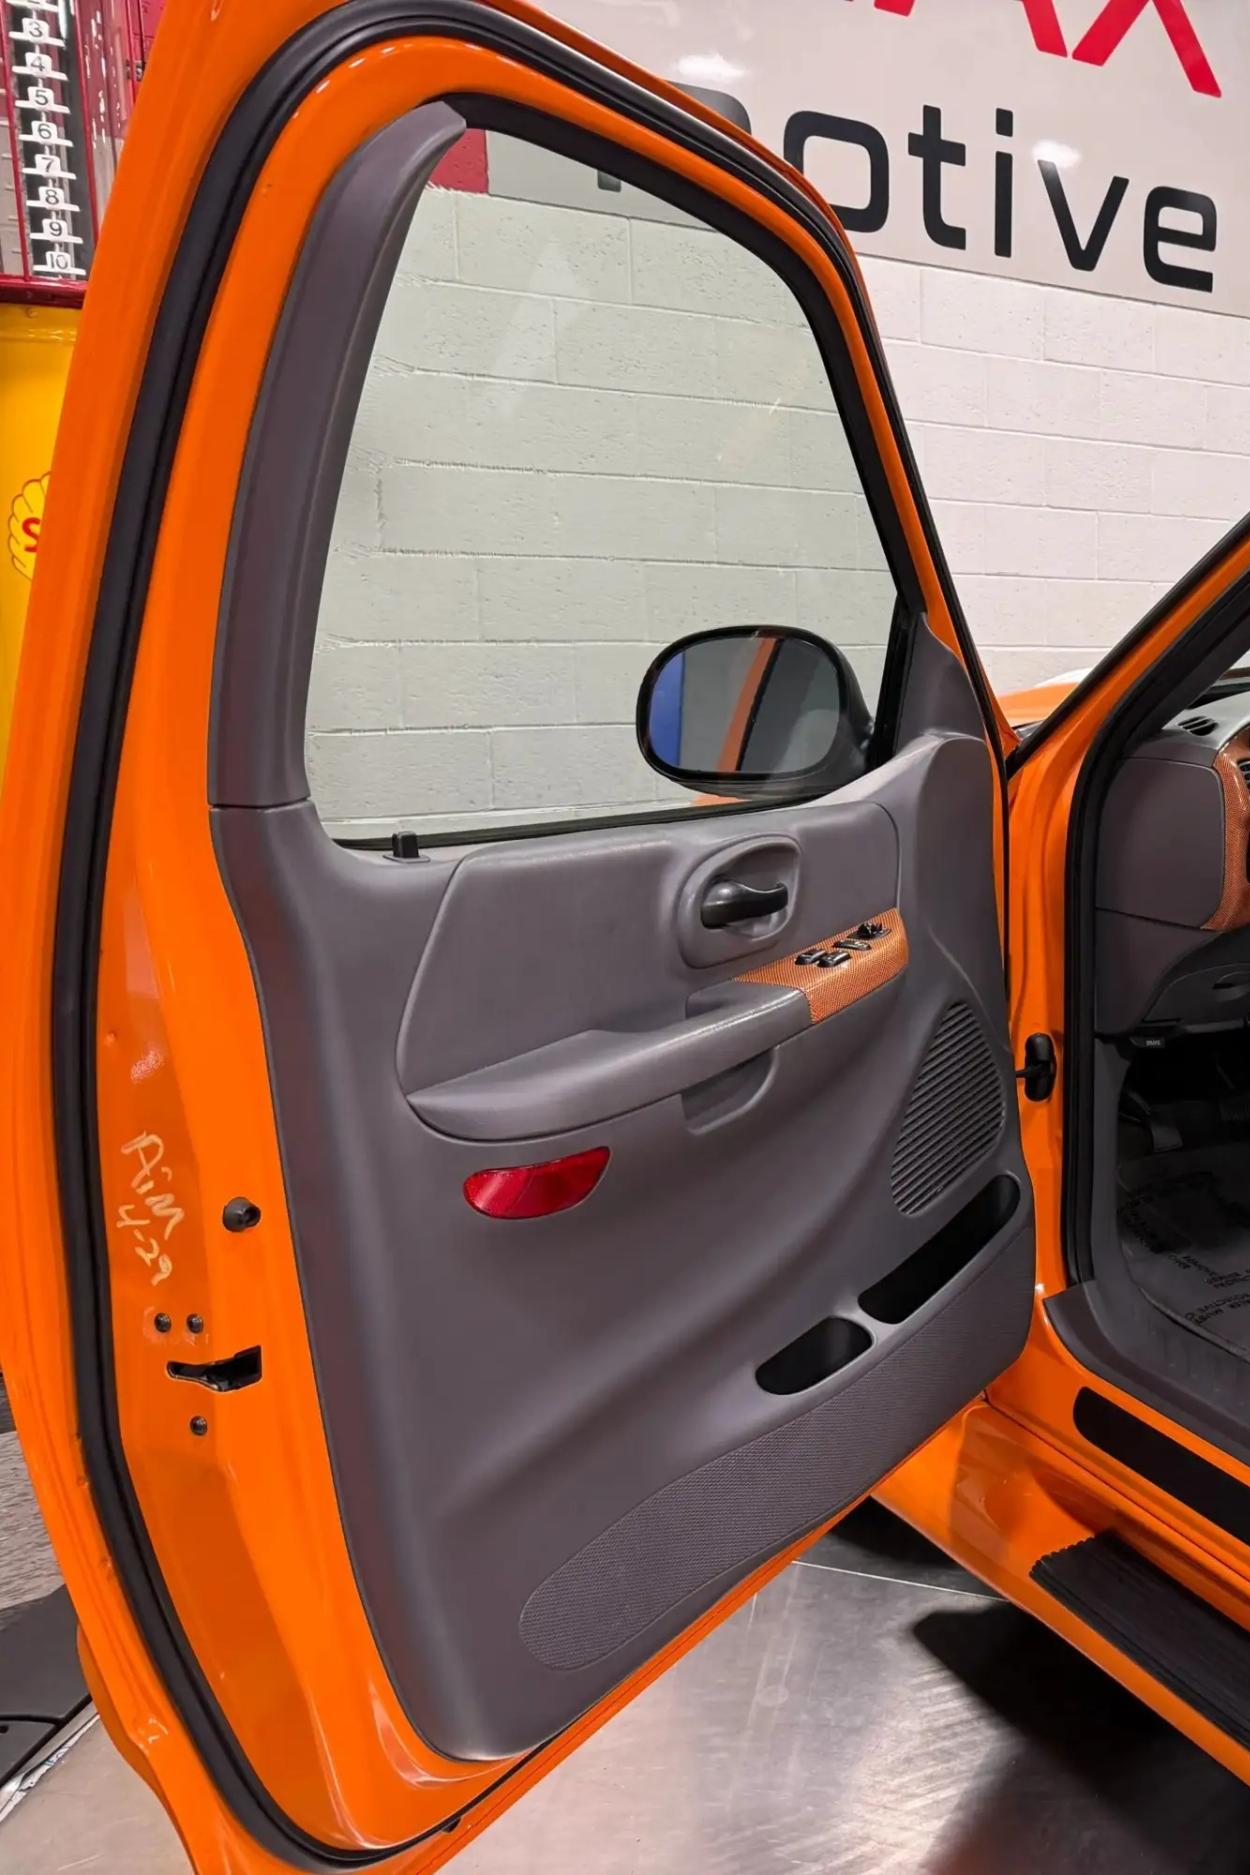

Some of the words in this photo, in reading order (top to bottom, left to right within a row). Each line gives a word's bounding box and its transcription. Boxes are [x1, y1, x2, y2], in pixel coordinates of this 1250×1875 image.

[28, 21, 44, 39] 3
[30, 56, 46, 73] 4
[34, 90, 49, 106] 5
[37, 123, 52, 140] 6
[41, 157, 55, 173] 7
[45, 190, 60, 206] 8
[49, 221, 63, 238] 9
[49, 253, 69, 271] 10
